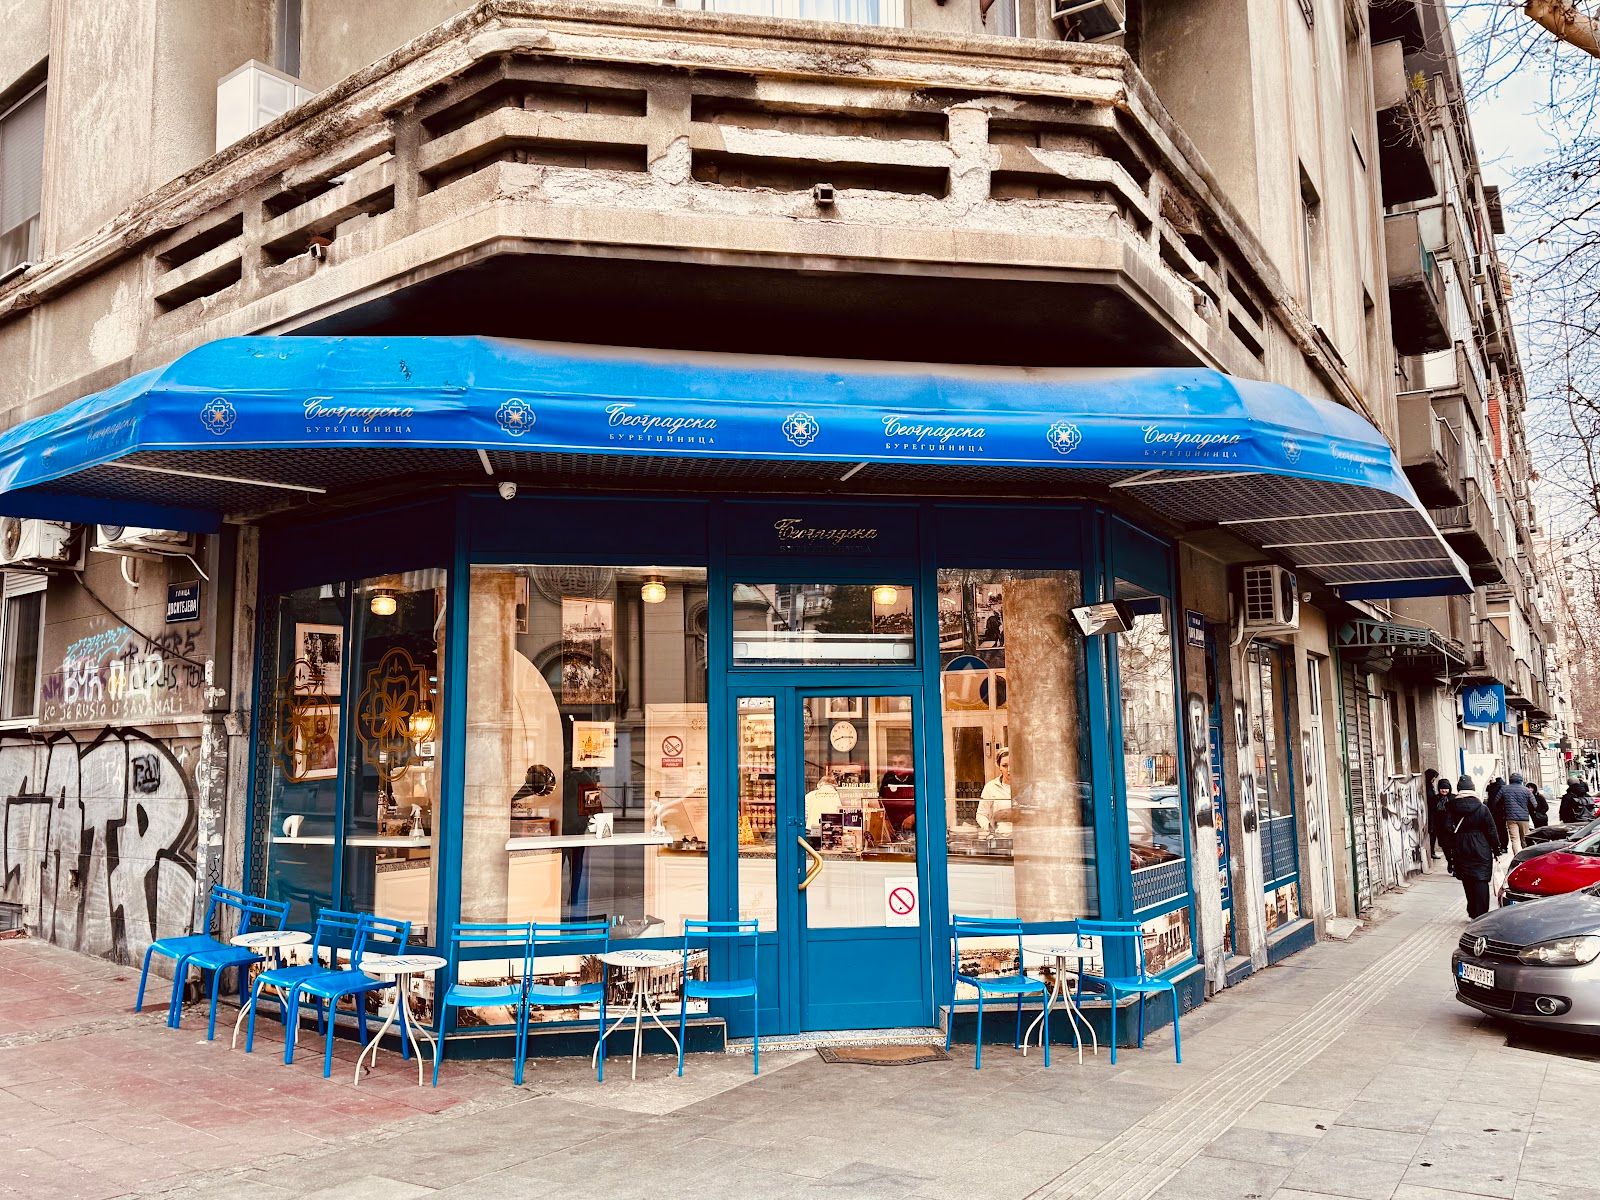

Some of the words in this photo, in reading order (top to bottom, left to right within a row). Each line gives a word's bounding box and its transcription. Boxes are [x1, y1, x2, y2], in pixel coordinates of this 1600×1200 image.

[303, 396, 414, 425] Београдска
[605, 403, 717, 434] Београдска
[882, 415, 986, 443] Београдска
